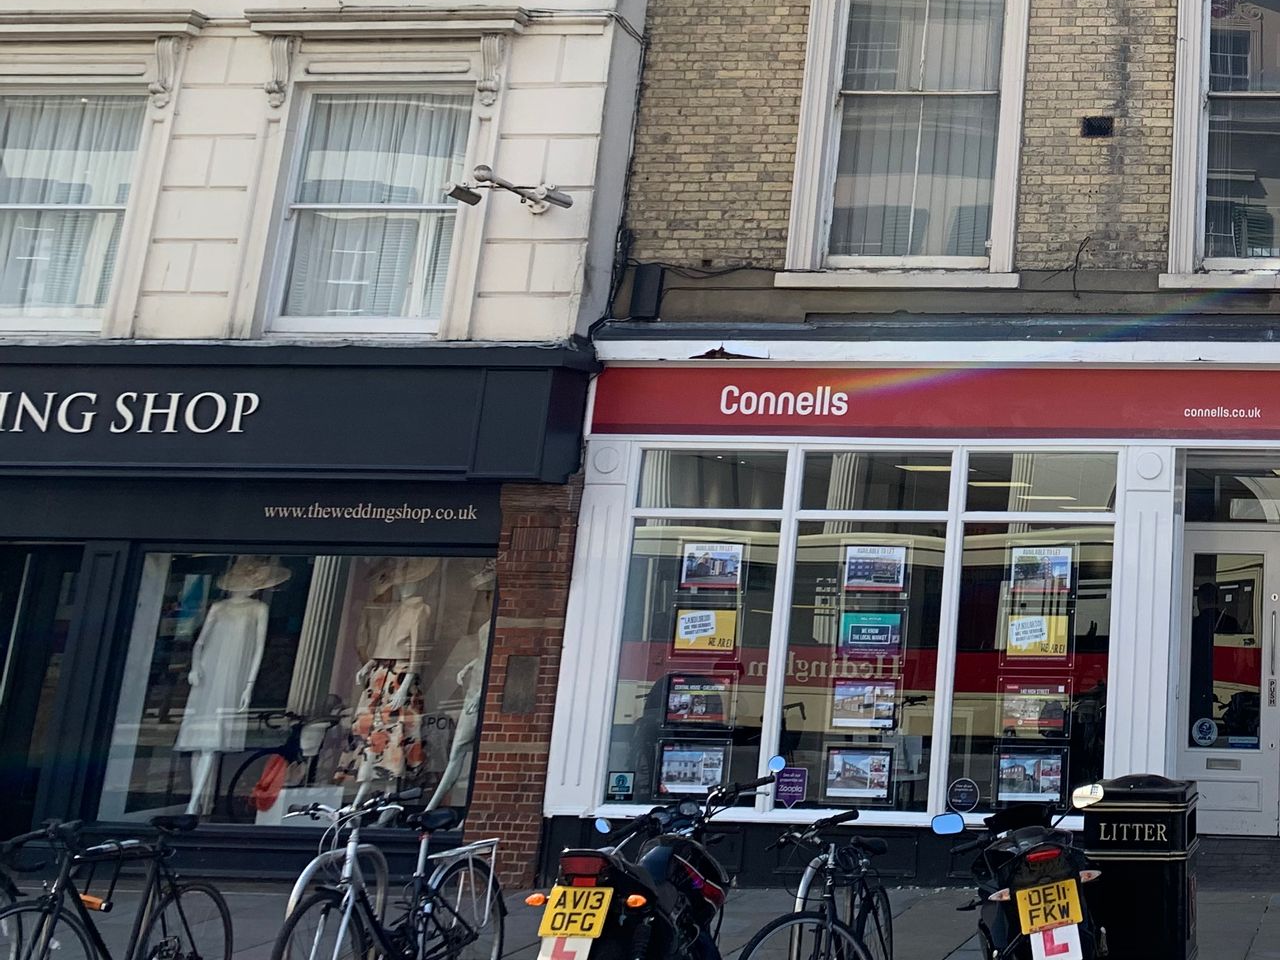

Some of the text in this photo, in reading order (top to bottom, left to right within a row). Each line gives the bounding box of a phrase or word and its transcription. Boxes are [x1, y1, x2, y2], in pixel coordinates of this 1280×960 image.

[720, 385, 849, 416] Connells
[109, 391, 260, 434] SHOP
[1184, 406, 1261, 418] connells.co.uk
[264, 502, 477, 523] www.theweddingshop.co.uk
[778, 785, 803, 793] Zoopla
[1099, 822, 1168, 842] LITTER
[554, 890, 605, 910] AV13
[1028, 885, 1067, 906] DE11
[551, 912, 596, 932] OFG
[1029, 902, 1070, 926] FKW
[1042, 929, 1070, 957] L
